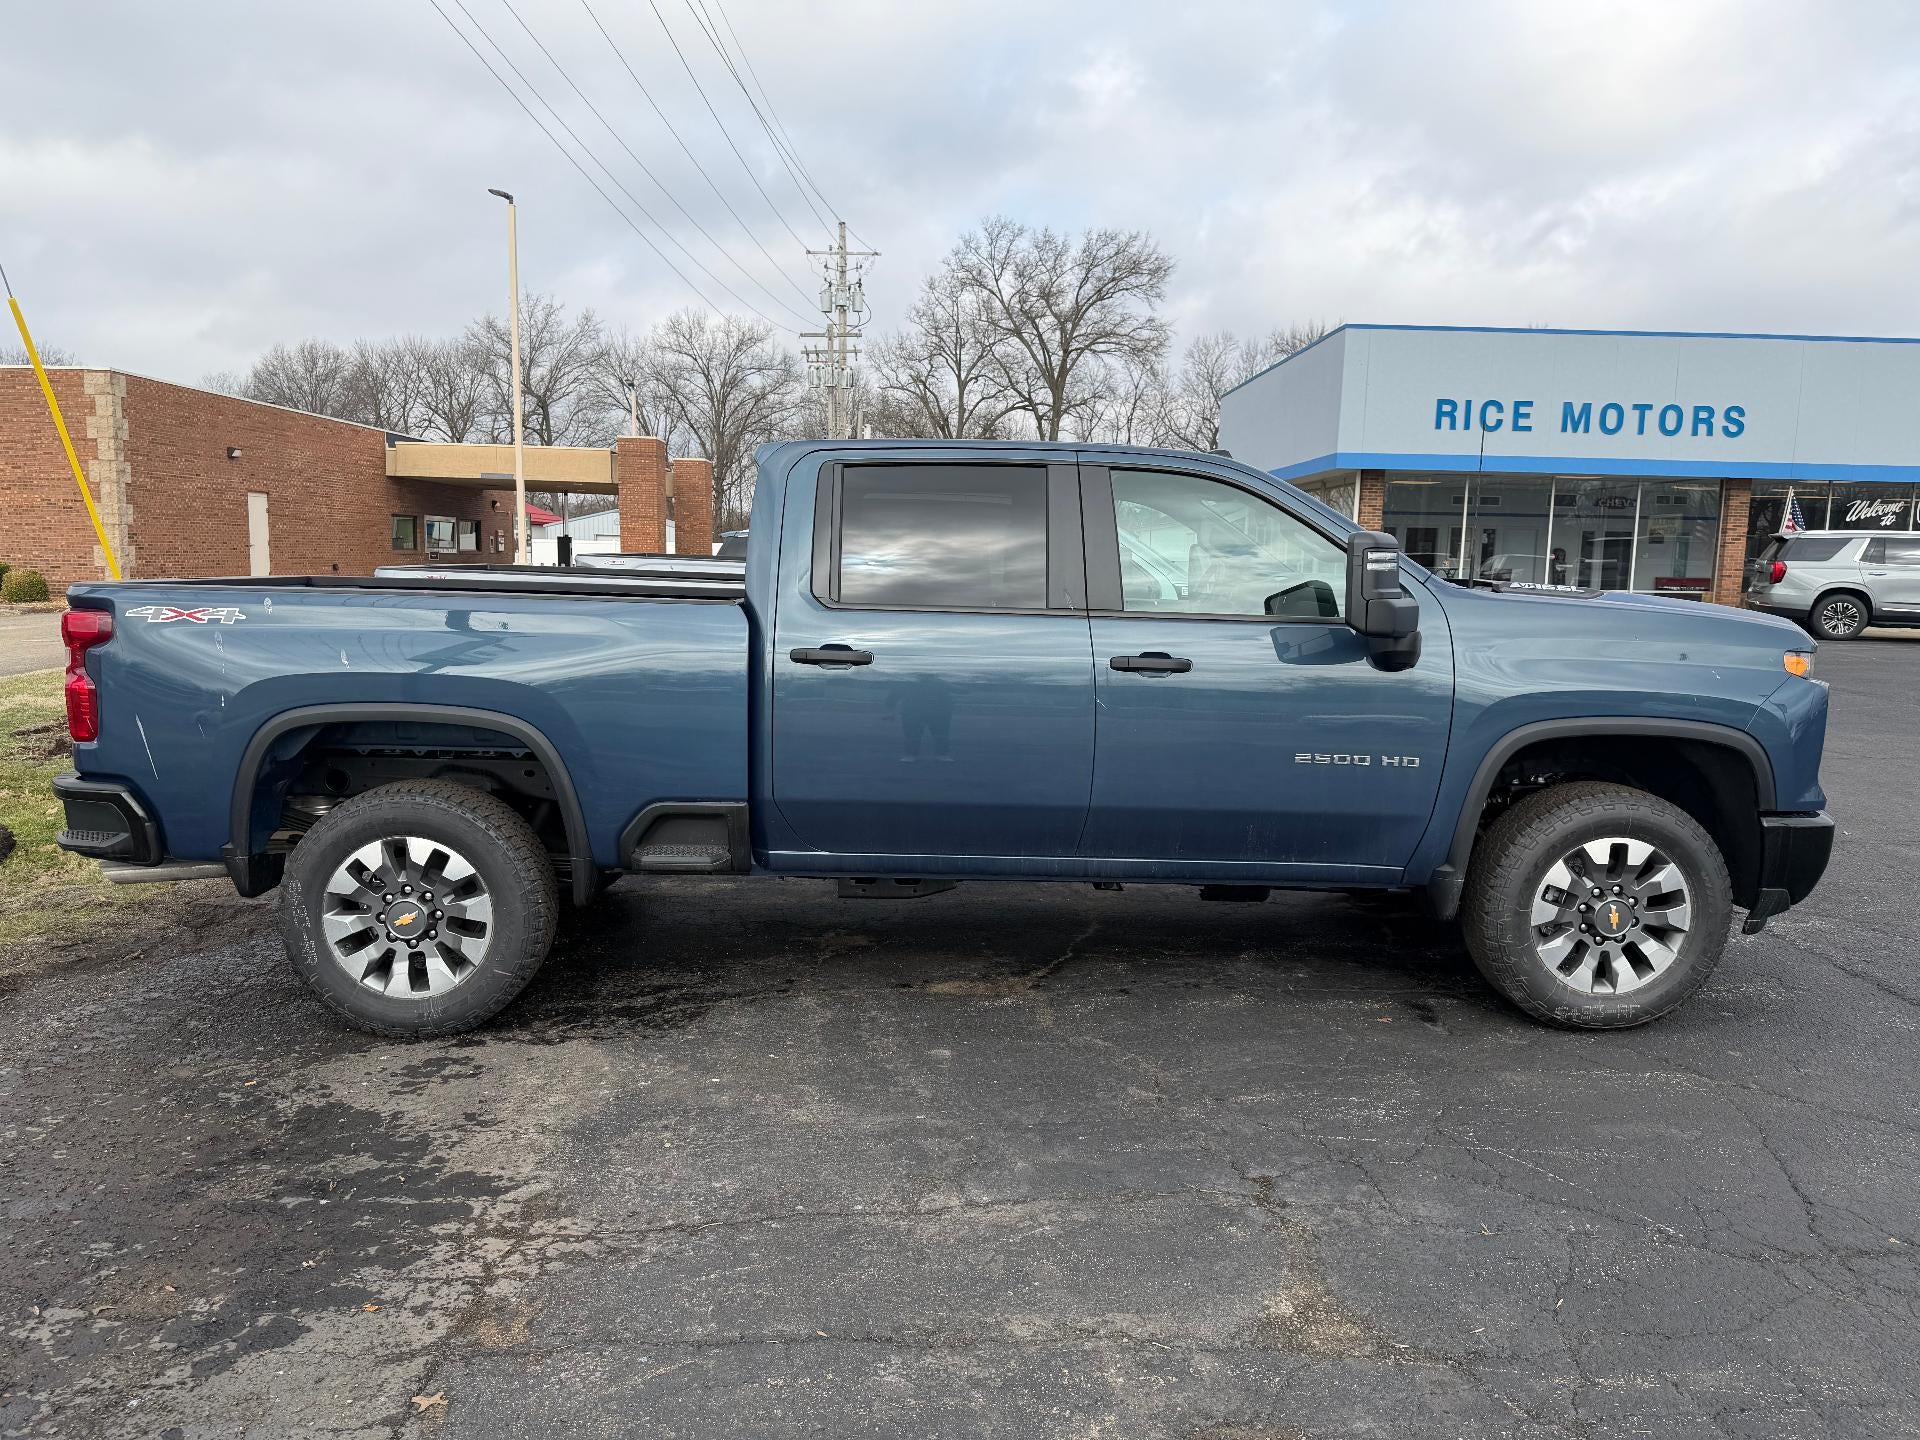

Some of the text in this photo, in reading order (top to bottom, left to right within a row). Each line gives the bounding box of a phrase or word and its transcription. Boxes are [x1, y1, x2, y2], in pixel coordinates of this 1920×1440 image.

[1435, 398, 1746, 438] RICE MOTORS
[1845, 499, 1905, 522] Welcome
[1880, 511, 1897, 527] to
[1294, 752, 1420, 767] 2500 HD
